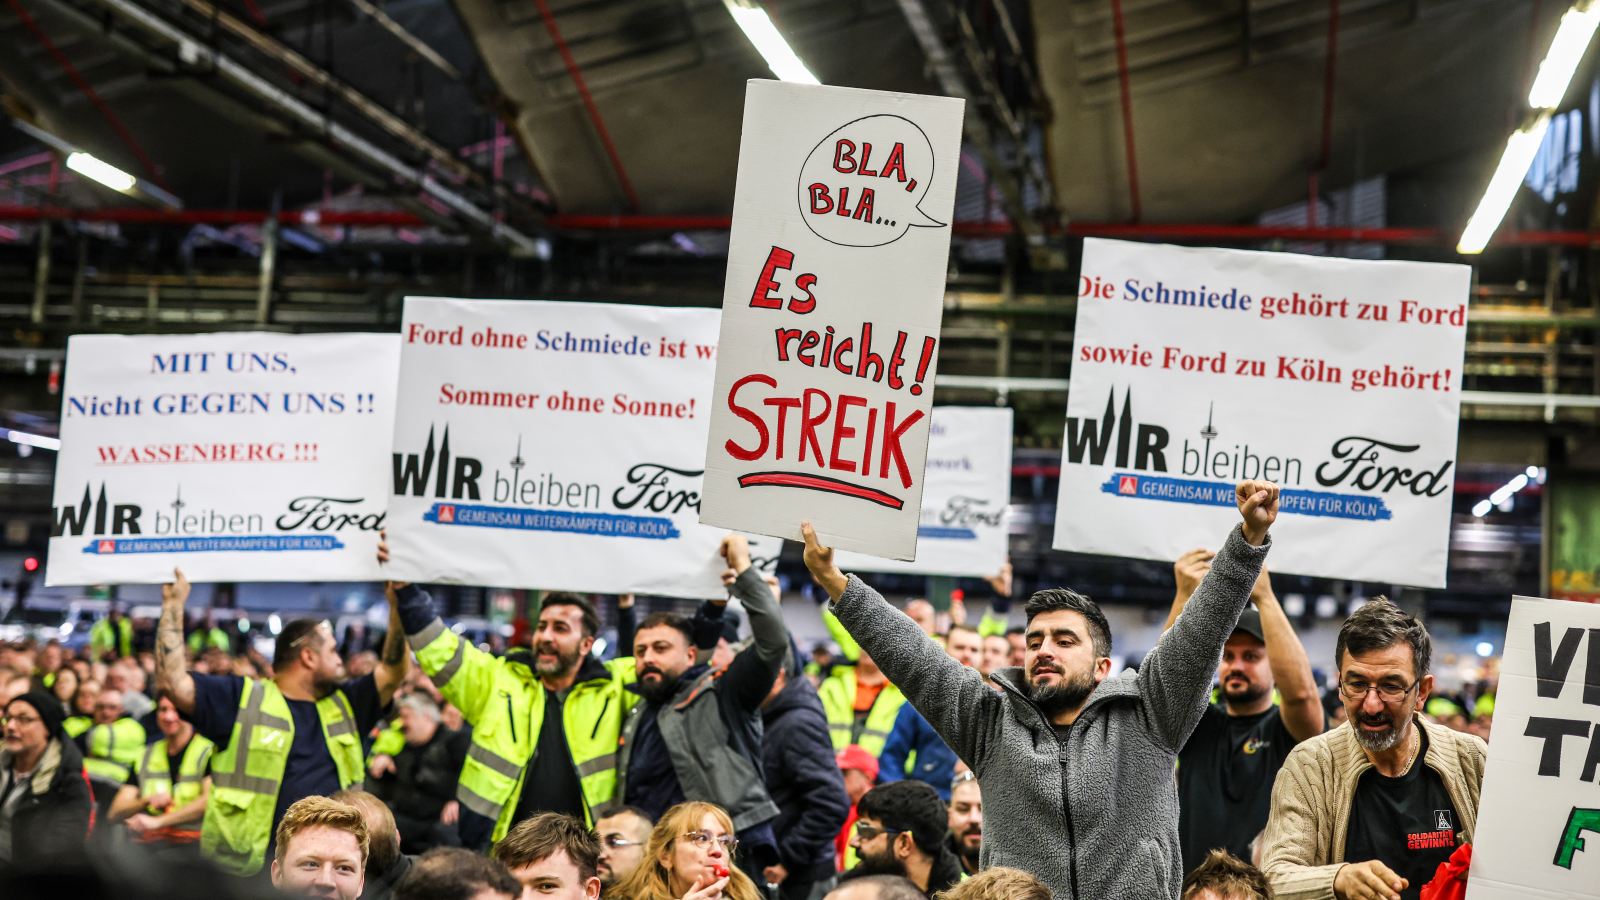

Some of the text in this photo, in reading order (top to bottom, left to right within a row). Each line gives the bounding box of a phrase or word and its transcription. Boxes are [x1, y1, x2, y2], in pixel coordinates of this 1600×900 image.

[832, 138, 918, 193] BLA,
[807, 182, 897, 227] BLA...
[748, 245, 818, 315] Es
[1123, 279, 1252, 311] Schmiede
[1259, 292, 1350, 319] gehört
[1356, 303, 1388, 322] zu
[1398, 300, 1465, 327] Ford
[408, 323, 464, 346] Ford
[471, 326, 528, 349] ohne
[535, 331, 651, 356] Schmiede
[659, 336, 687, 359] ist
[774, 321, 937, 396] reicht!
[151, 352, 298, 375] MIT UNS,
[1080, 343, 1452, 392] sowie Ford zu Köln gehört!
[67, 395, 143, 417] Nicht
[152, 393, 270, 414] GEGEN
[282, 392, 346, 414] UNS
[439, 383, 697, 419] Sommer ohne Sonne!
[724, 373, 925, 489] STREIK
[1066, 384, 1453, 498] WIR bleiben Ford
[97, 443, 285, 464] WASSENBERG
[392, 423, 705, 514] WIR bleiben For
[51, 481, 387, 537] WIR bleiben Ford
[939, 495, 1005, 527] Ford
[1141, 481, 1213, 501] GEMEINSAM
[1319, 497, 1343, 514] FÜR
[1345, 500, 1378, 517] KÖLN
[457, 509, 668, 536] GEMEINSAM WEITERKÄMPFEN FÜR KÖLN
[119, 536, 333, 553] GEMEINSAM WEITERKÄMPFEN FÜR KÖLN
[1407, 831, 1450, 842] SOLIDARITÄT
